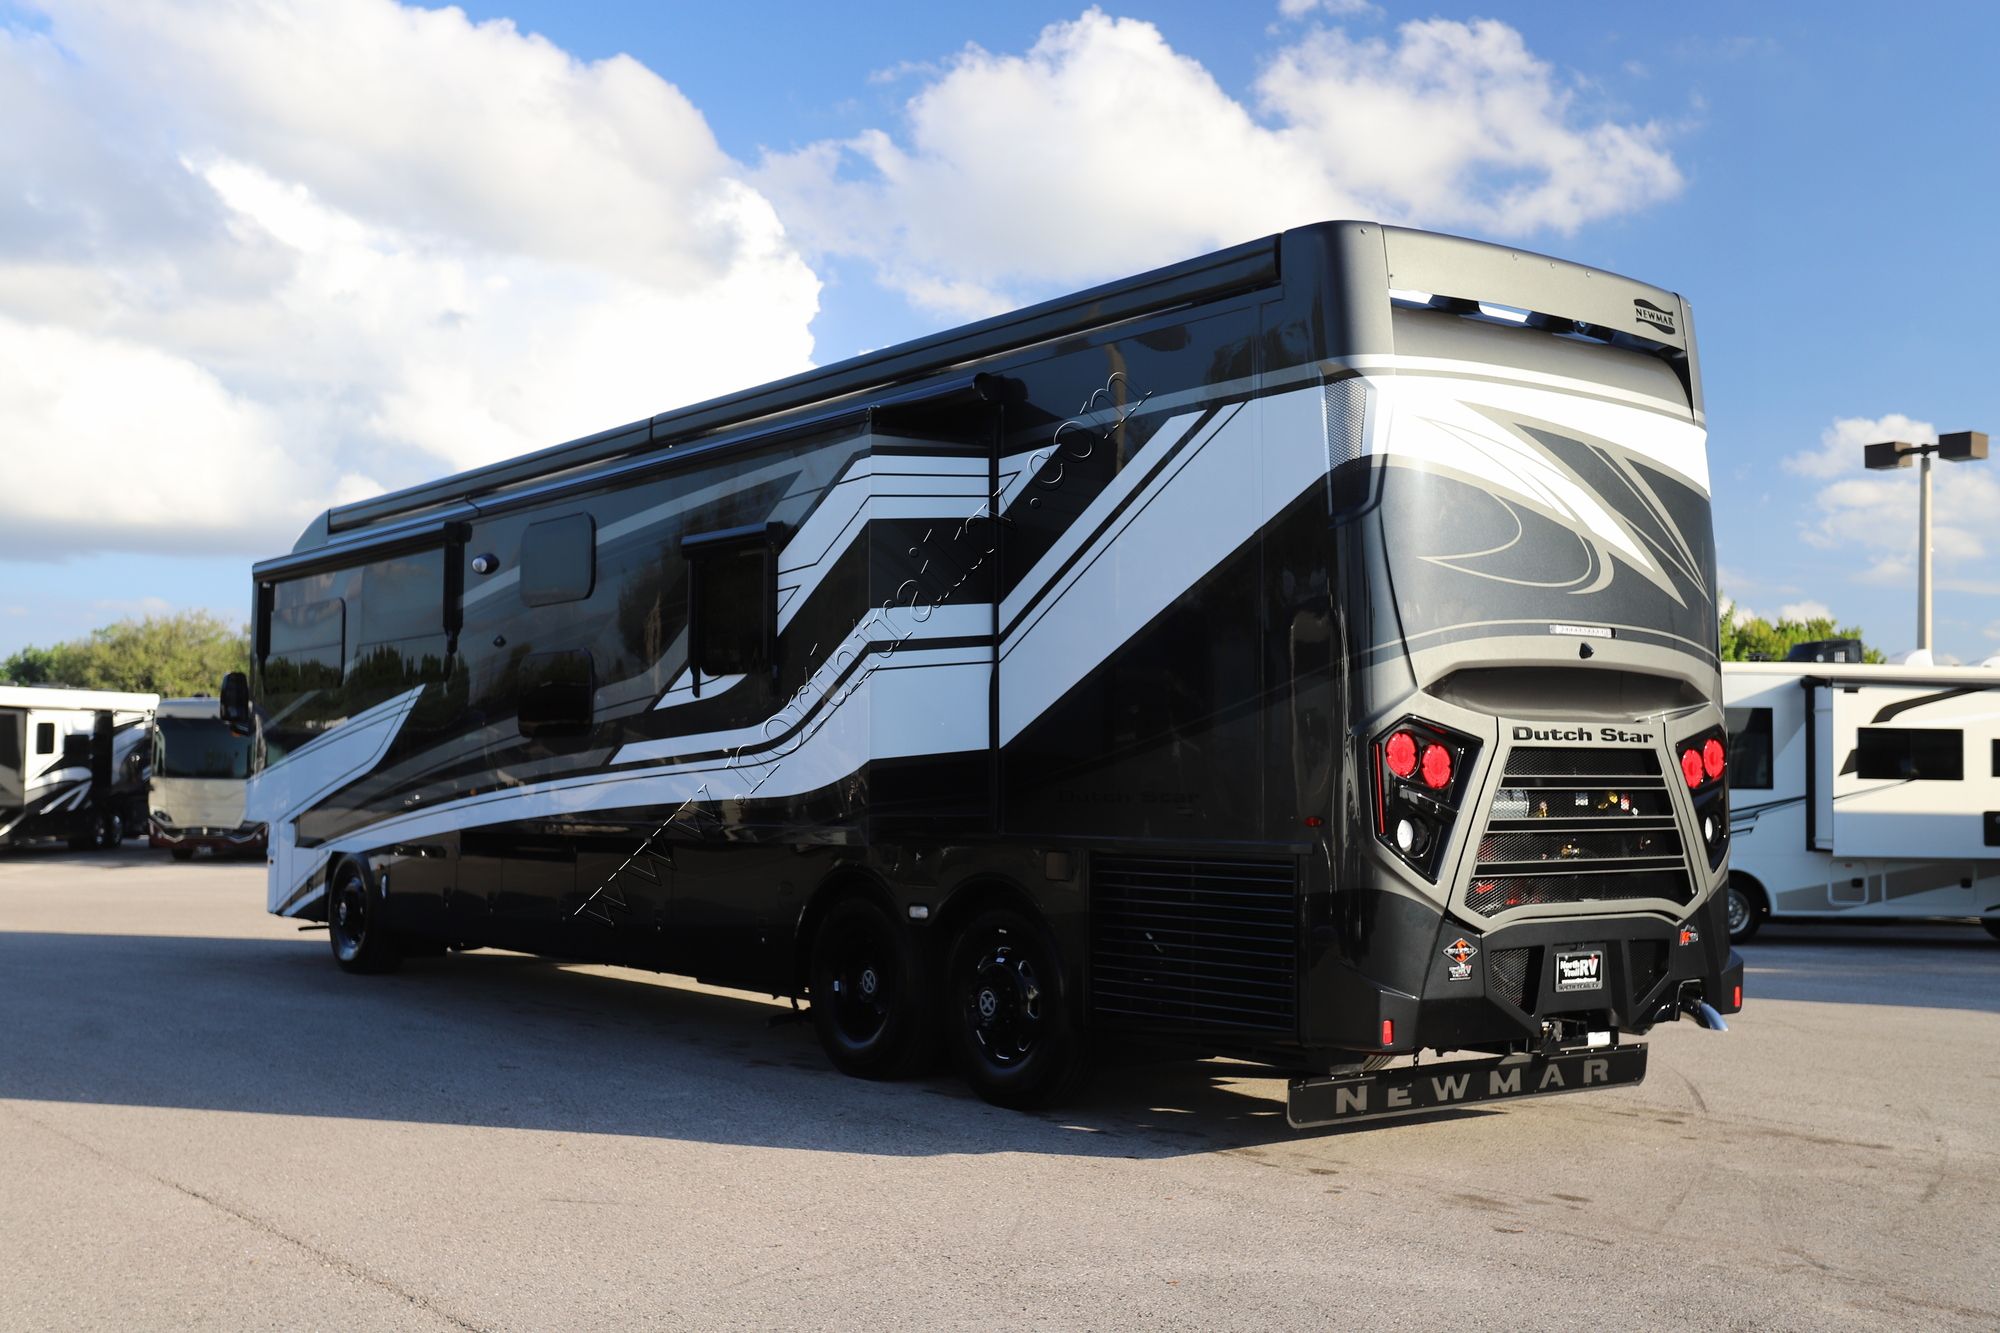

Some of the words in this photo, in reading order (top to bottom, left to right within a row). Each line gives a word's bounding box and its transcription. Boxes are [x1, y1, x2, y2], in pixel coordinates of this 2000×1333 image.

[1635, 308, 1674, 327] NEWMAR
[1512, 726, 1593, 742] Dutch
[1600, 728, 1654, 743] Star
[1056, 790, 1131, 804] Dutch
[1139, 790, 1200, 804] Star
[1580, 958, 1599, 976] RV
[1335, 1058, 1610, 1114] NEWMAR
